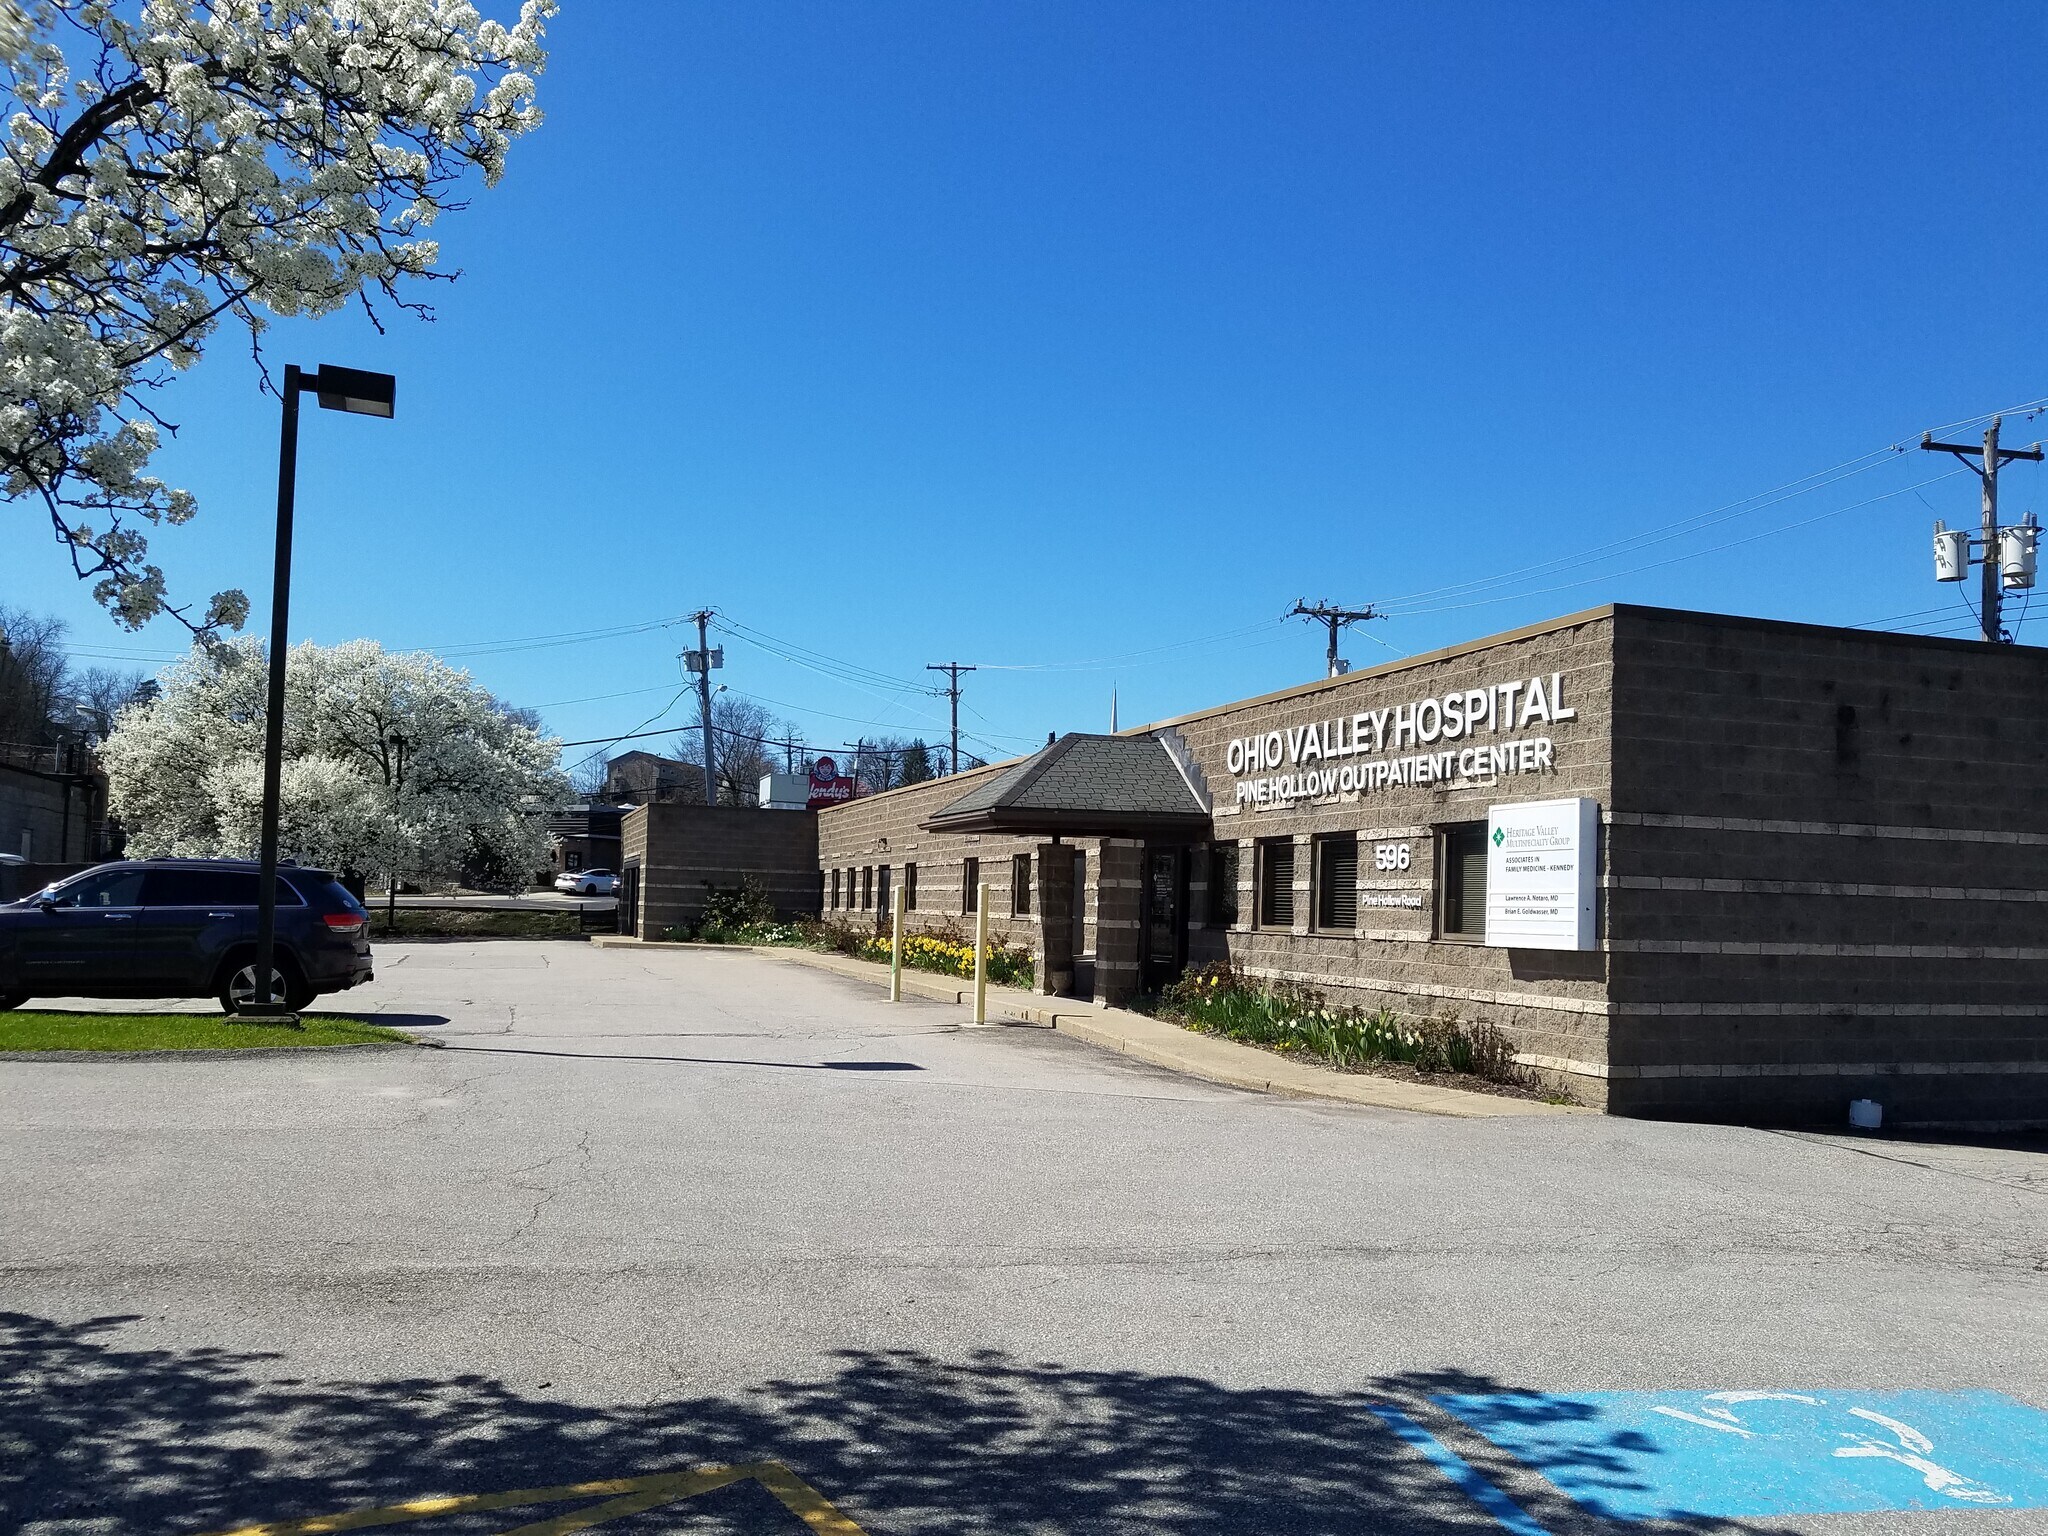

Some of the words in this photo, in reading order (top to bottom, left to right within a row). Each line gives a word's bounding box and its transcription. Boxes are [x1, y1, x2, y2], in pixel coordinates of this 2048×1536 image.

[1227, 731, 1282, 774] OHIO
[1286, 707, 1390, 765] VALLEY
[1395, 672, 1575, 747] HOSPITAL
[1236, 777, 1267, 804] PINE
[1268, 770, 1336, 801] HOLLOW
[1340, 750, 1458, 792] OUTPATIENT
[1460, 737, 1554, 776] CENTER
[1506, 827, 1535, 838] HERITAGE
[1536, 825, 1559, 836] VALLEY
[1505, 837, 1549, 848] MULTISPECIALTY
[1549, 836, 1571, 846] GROUP
[1375, 843, 1410, 870] 596
[1505, 856, 1534, 864] ASSOCIATES
[1362, 894, 1378, 906] Pine
[1378, 894, 1402, 906] Hollow
[1402, 894, 1422, 907] Road
